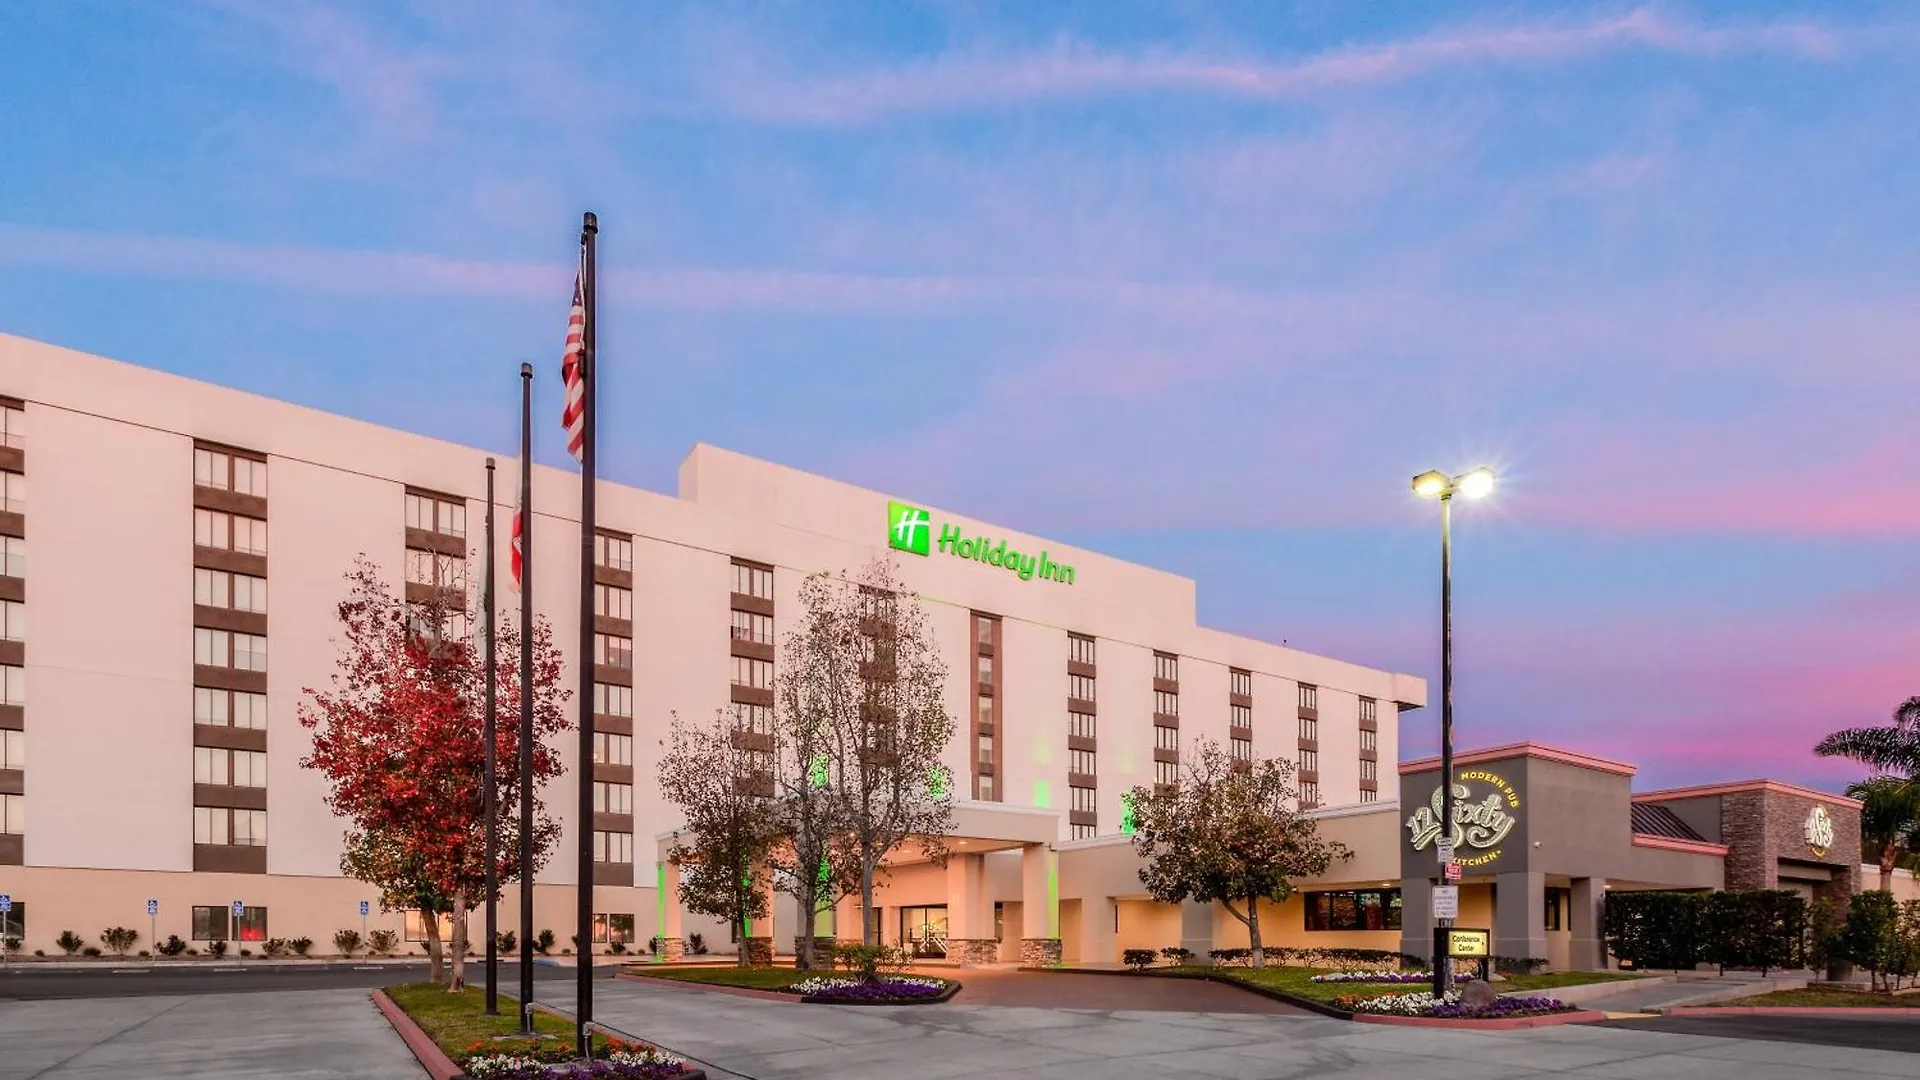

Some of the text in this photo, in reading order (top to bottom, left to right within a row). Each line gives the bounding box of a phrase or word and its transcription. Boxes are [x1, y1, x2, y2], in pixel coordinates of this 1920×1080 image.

[938, 523, 1075, 585] Holiday Inn
[1461, 771, 1519, 808] MODERN PUB
[1452, 934, 1480, 942] Conference
